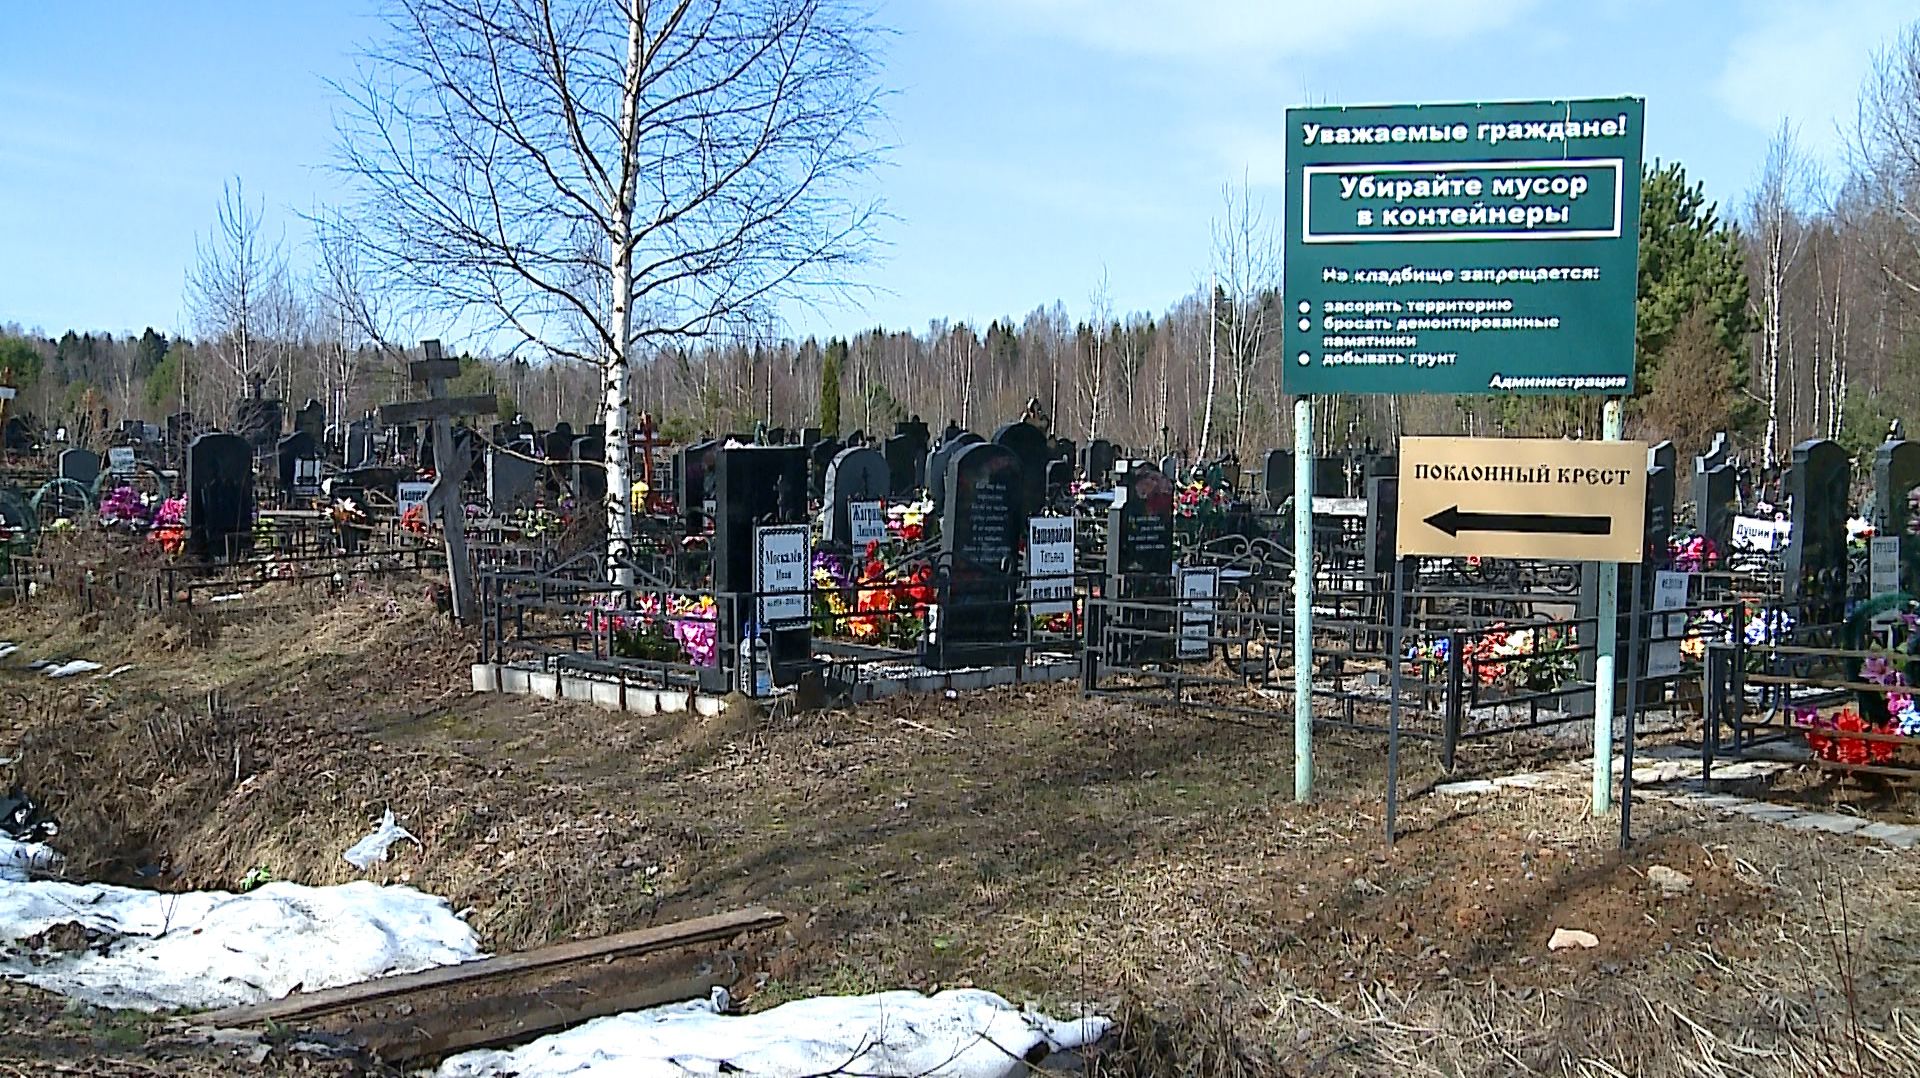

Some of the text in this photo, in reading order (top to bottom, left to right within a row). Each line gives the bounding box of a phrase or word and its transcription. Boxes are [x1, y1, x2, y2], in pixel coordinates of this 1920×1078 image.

[1302, 115, 1627, 146] Уважаемые граждане!
[1340, 172, 1588, 201] Убирайте мусор
[1357, 202, 1569, 228] в контейнеры
[1323, 266, 1600, 285] На кладбище запрещается:
[1323, 300, 1513, 315] засорять территорию
[1323, 315, 1560, 331] бросать демонтированные
[1323, 335, 1417, 348] памятники
[1322, 351, 1457, 366] добывать грунт
[1489, 374, 1627, 389] Администрация
[1415, 464, 1631, 485] ПОКЛОННЫЙ КРЕСТ
